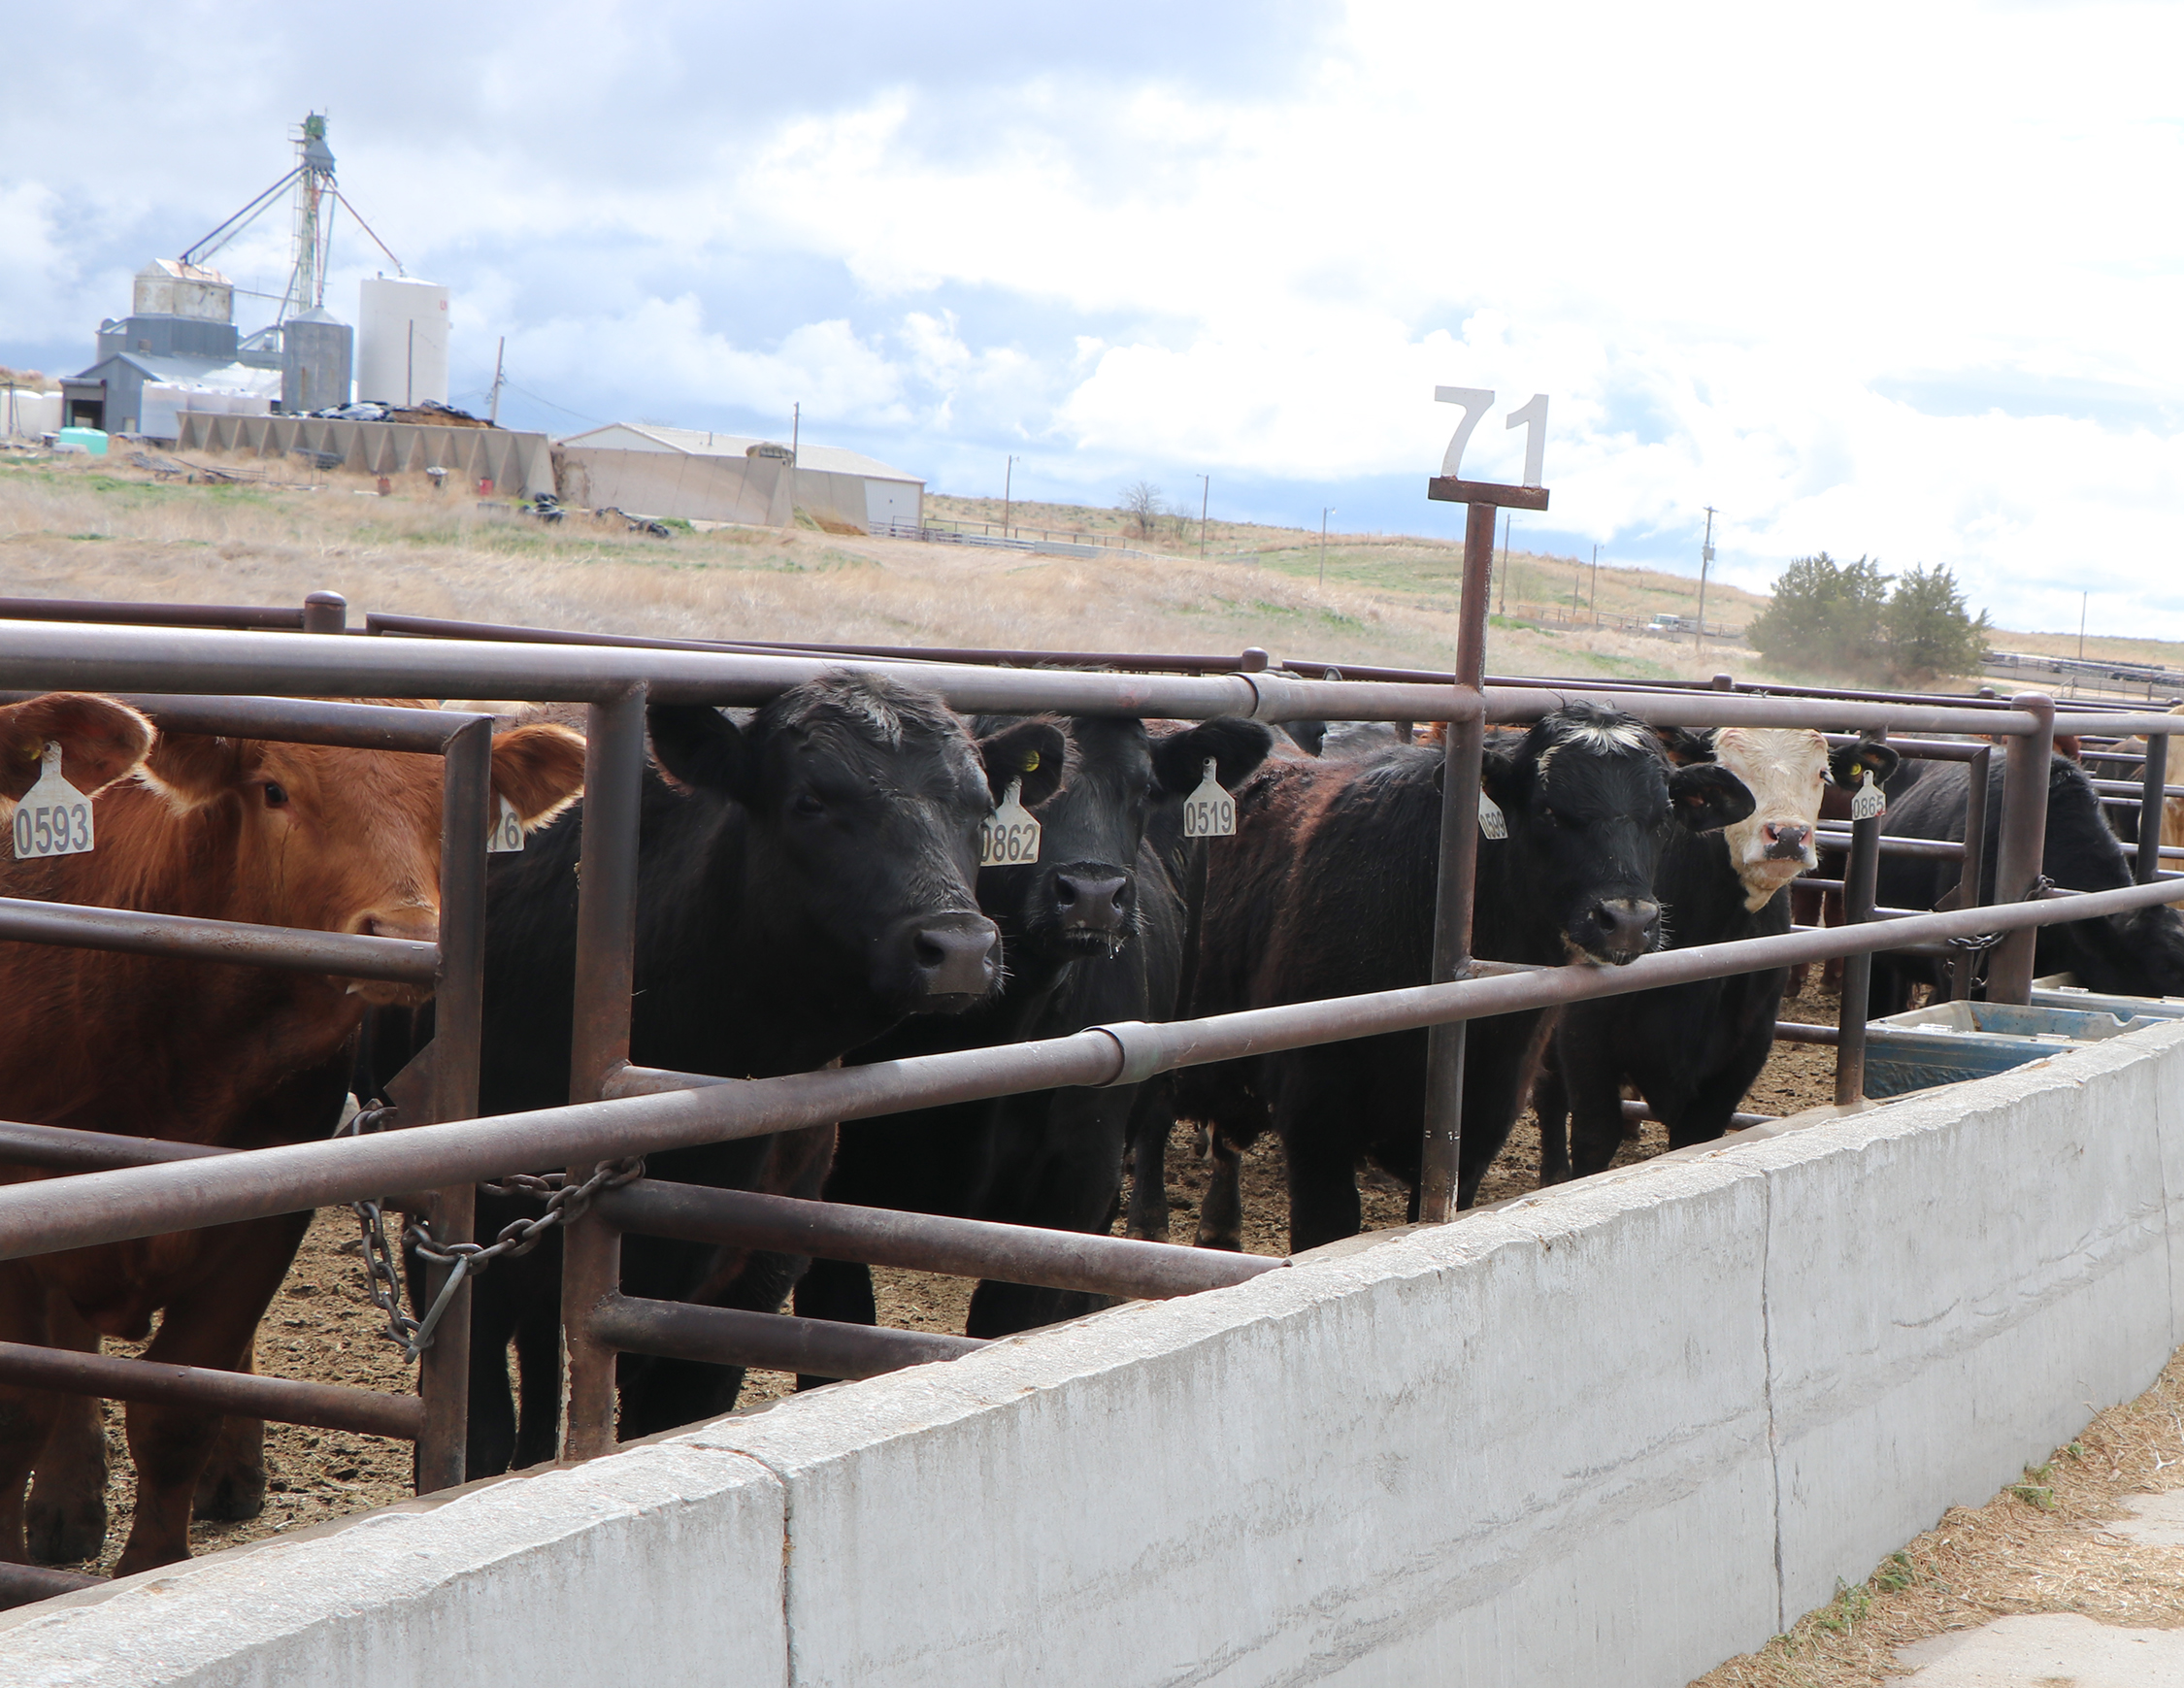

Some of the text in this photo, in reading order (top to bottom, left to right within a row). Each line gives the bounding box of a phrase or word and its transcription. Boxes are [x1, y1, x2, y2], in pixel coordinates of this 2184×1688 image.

[1434, 384, 1549, 487] 71
[1185, 801, 1232, 835] 0519
[1853, 795, 1884, 818] 0865
[16, 804, 88, 855] 0593
[1479, 811, 1506, 839] 0599
